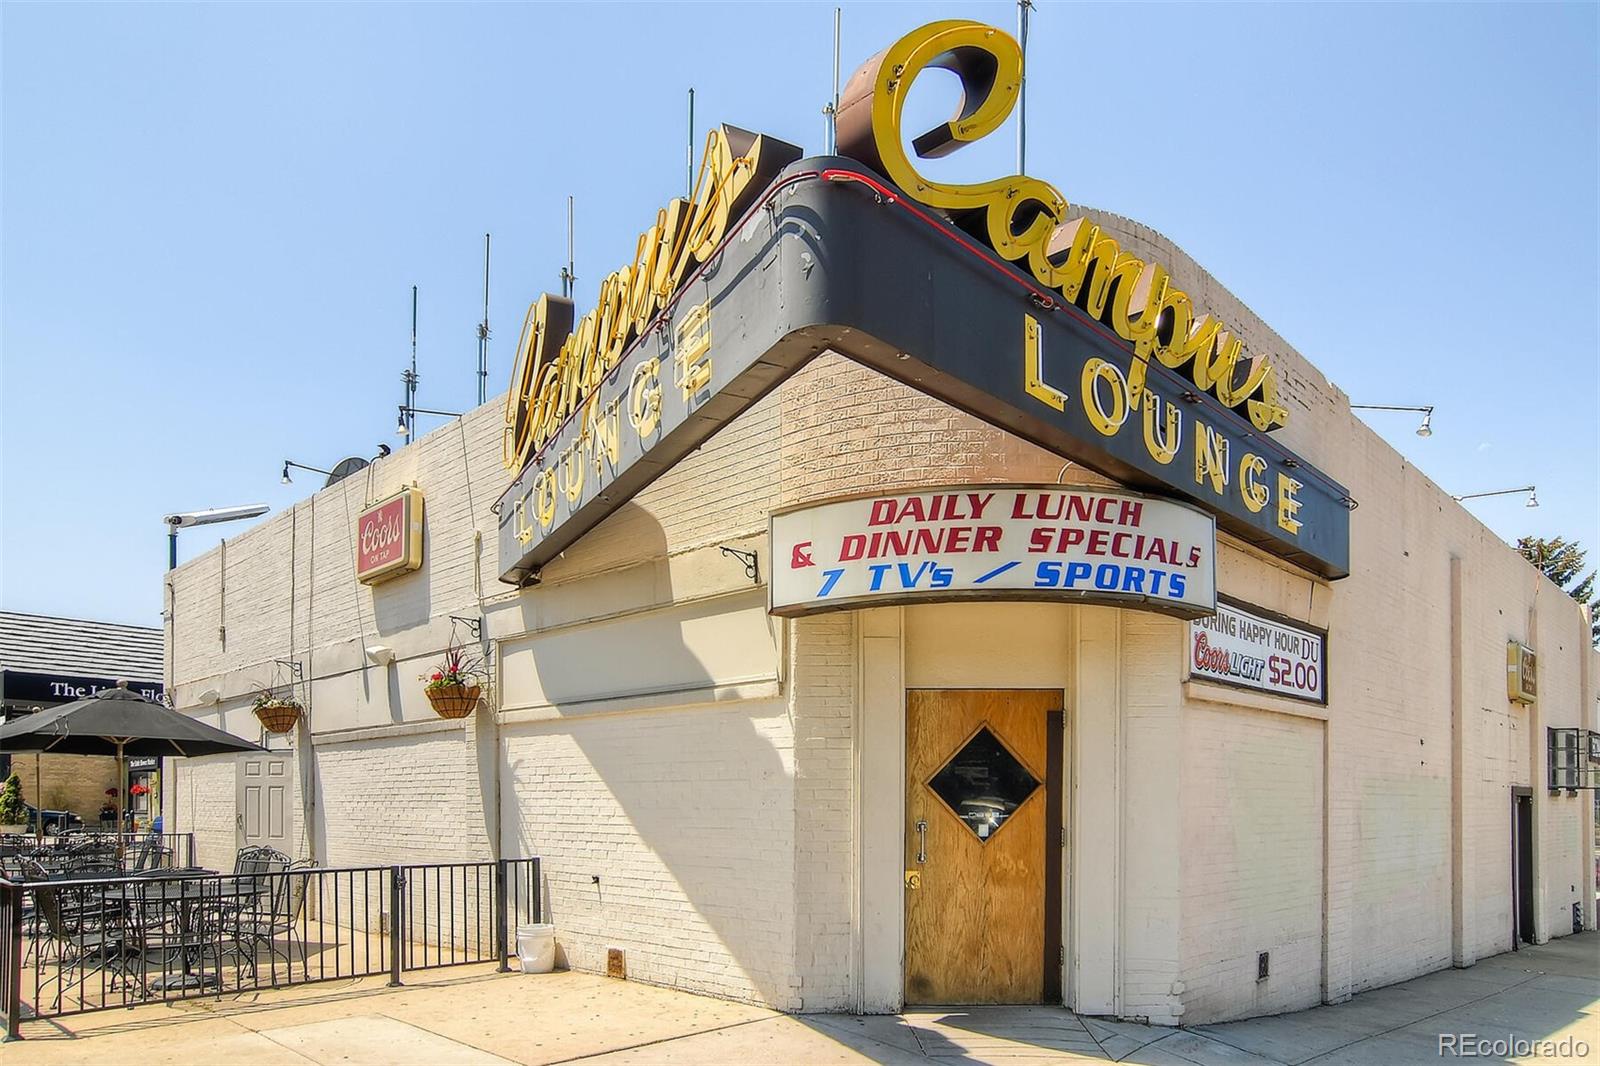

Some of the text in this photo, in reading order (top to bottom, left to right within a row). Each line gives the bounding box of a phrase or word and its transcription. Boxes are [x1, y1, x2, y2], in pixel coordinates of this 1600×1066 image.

[872, 18, 1289, 431] Campus
[513, 299, 713, 546] LOUNGE
[1024, 313, 1305, 535] LOUNGE
[868, 493, 1144, 528] DAILY LUNCH
[361, 514, 400, 555] Coors
[380, 549, 390, 559] TAP
[791, 526, 1202, 569] & DINNER SPECIALS
[816, 568, 847, 597] 7
[869, 561, 954, 591] TV's
[1033, 561, 1188, 599] SPORTS
[1194, 631, 1318, 692] Coors LIGHT $2.00
[1240, 619, 1272, 647] HAPPY
[1274, 631, 1300, 655] HOUR
[1301, 638, 1319, 662] DU
[50, 681, 86, 698] The
